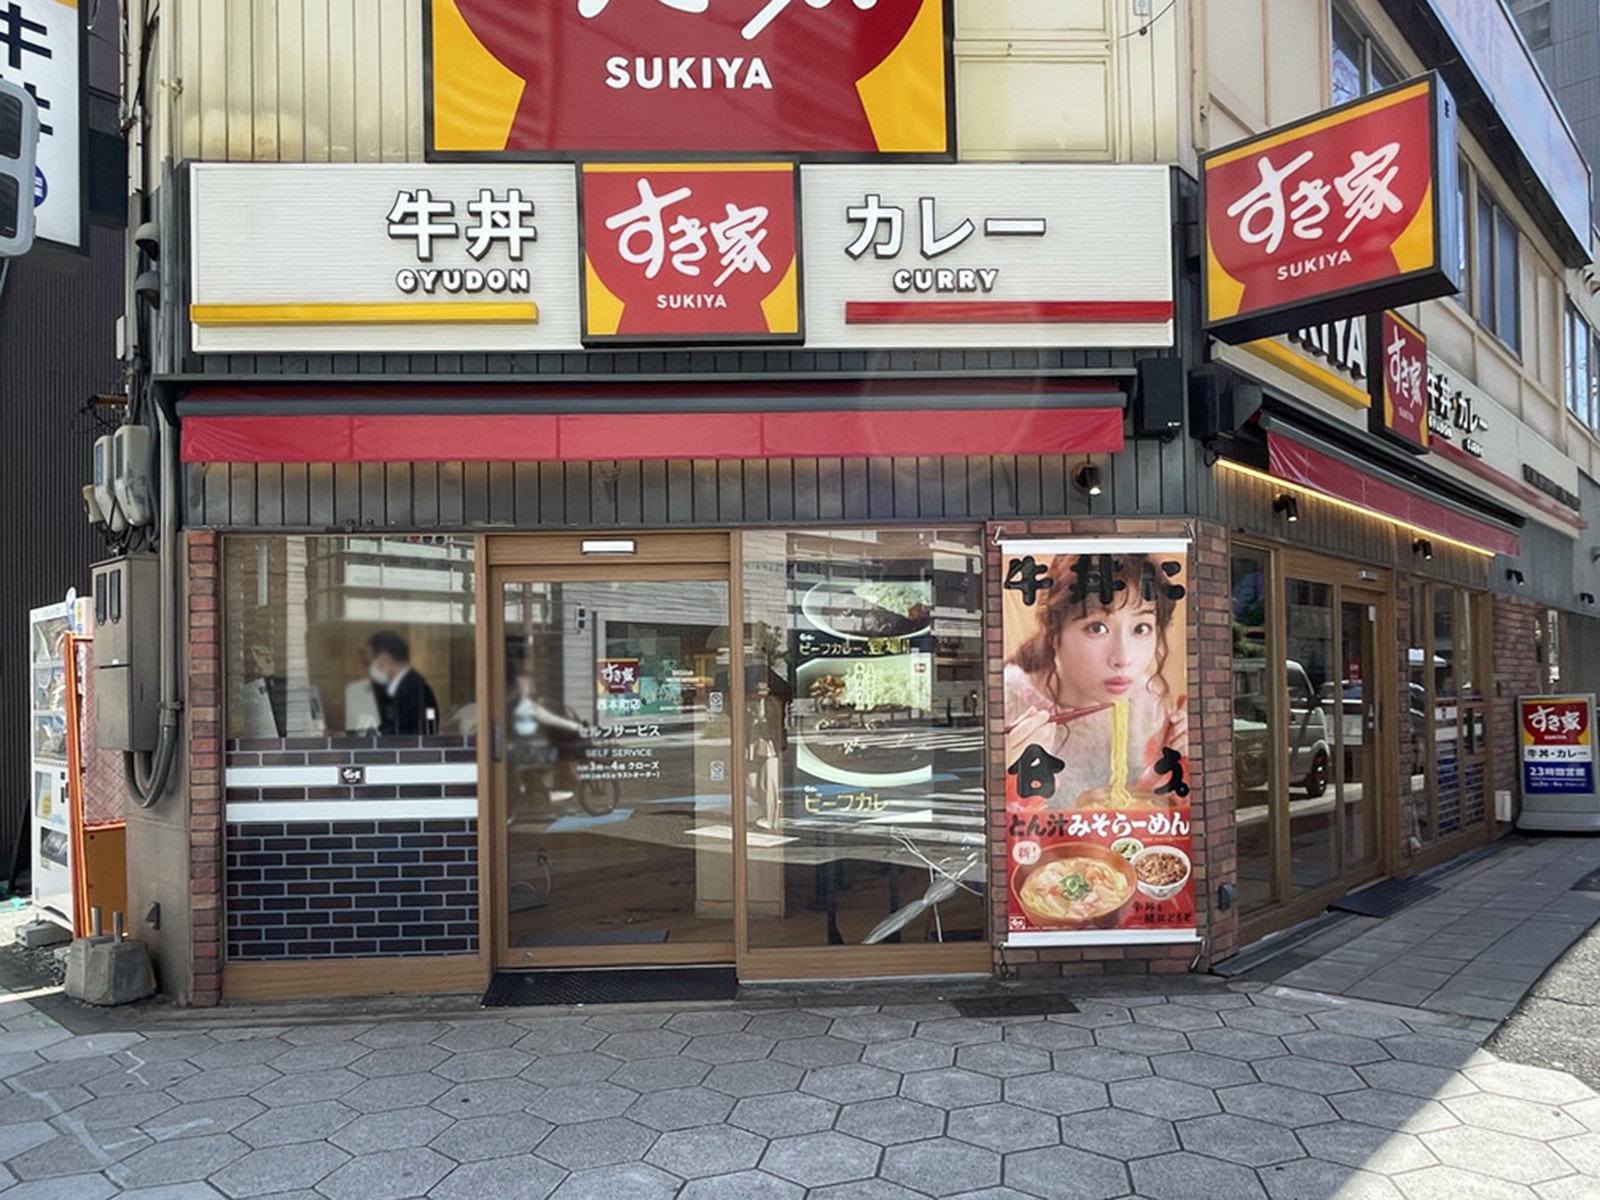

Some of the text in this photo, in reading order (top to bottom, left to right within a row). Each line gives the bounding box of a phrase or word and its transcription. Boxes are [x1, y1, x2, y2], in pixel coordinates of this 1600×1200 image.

[605, 56, 773, 90] SUKIYA
[1227, 142, 1404, 255] すき家
[387, 189, 536, 261] 牛丼
[605, 178, 771, 287] すき家
[845, 194, 1046, 259] カレー
[397, 269, 531, 293] GYUDON
[893, 268, 999, 292] CURRY
[1276, 248, 1353, 281] SUKIYA
[656, 294, 728, 309] SUKIYA
[1387, 325, 1423, 409] すき家
[600, 663, 635, 684] すき家
[1528, 705, 1582, 734] すき家
[1008, 812, 1190, 838] とん汁みそらーめん
